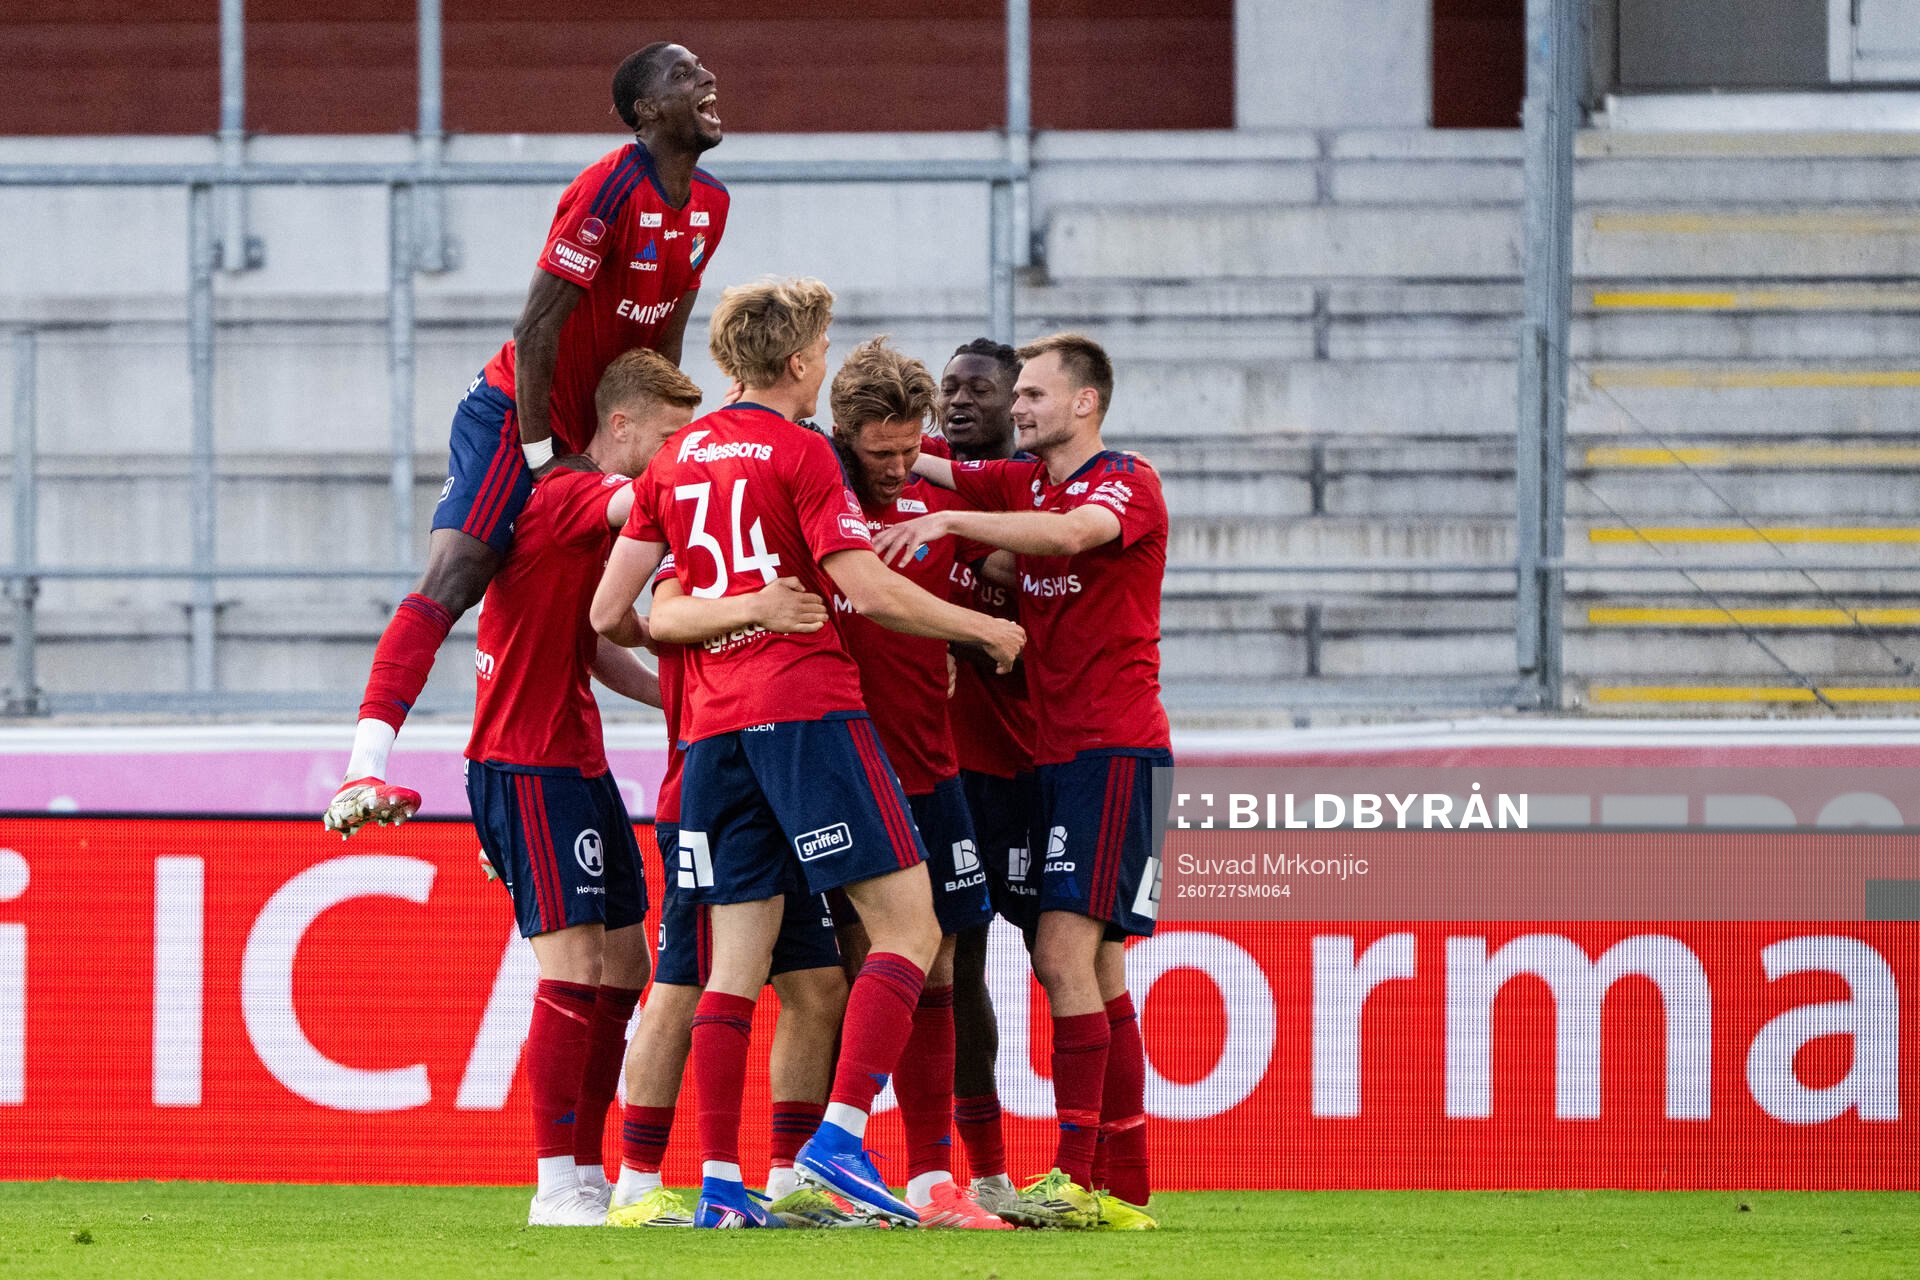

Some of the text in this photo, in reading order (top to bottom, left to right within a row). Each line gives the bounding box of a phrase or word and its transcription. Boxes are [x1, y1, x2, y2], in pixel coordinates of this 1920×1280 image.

[555, 243, 597, 270] UNIBET
[677, 430, 773, 463] Fellessons
[675, 479, 781, 599] 34
[803, 829, 844, 856] griffel
[872, 911, 1903, 1124] torma
